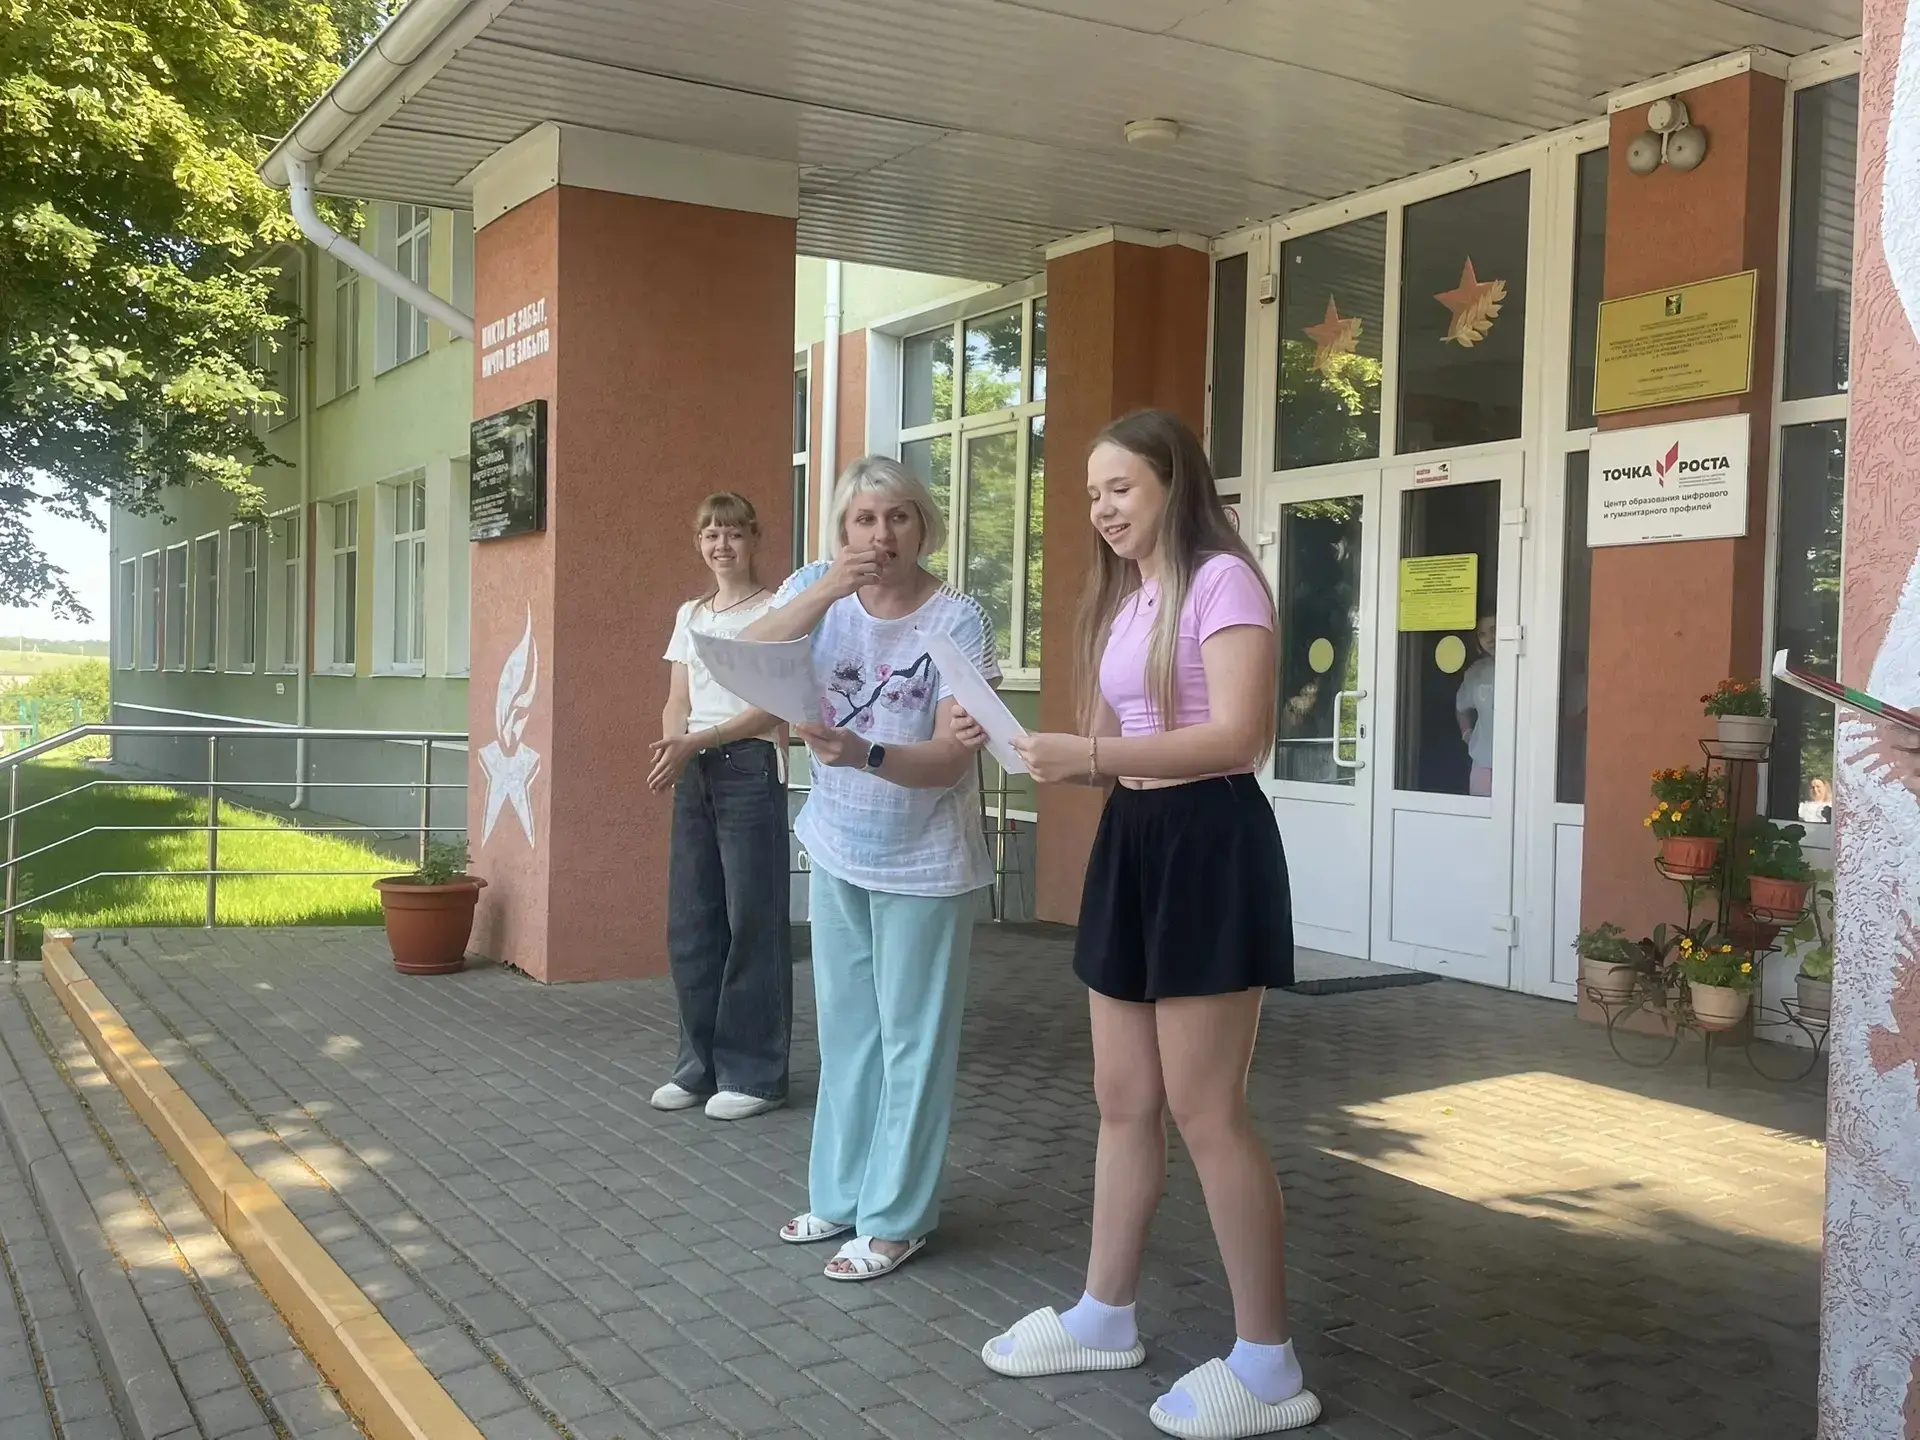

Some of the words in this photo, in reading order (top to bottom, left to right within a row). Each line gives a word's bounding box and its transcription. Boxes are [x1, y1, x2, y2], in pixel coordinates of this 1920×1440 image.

[506, 312, 516, 338] НЕ
[505, 342, 516, 368] НЕ
[1602, 464, 1652, 482] ТОЧКА
[1678, 456, 1730, 473] РОСТА
[1603, 499, 1627, 509] Центр
[1628, 493, 1680, 506] образования
[1682, 489, 1729, 502] цифрового
[1610, 508, 1668, 520] гуманитарного
[1669, 501, 1712, 515] профилей
